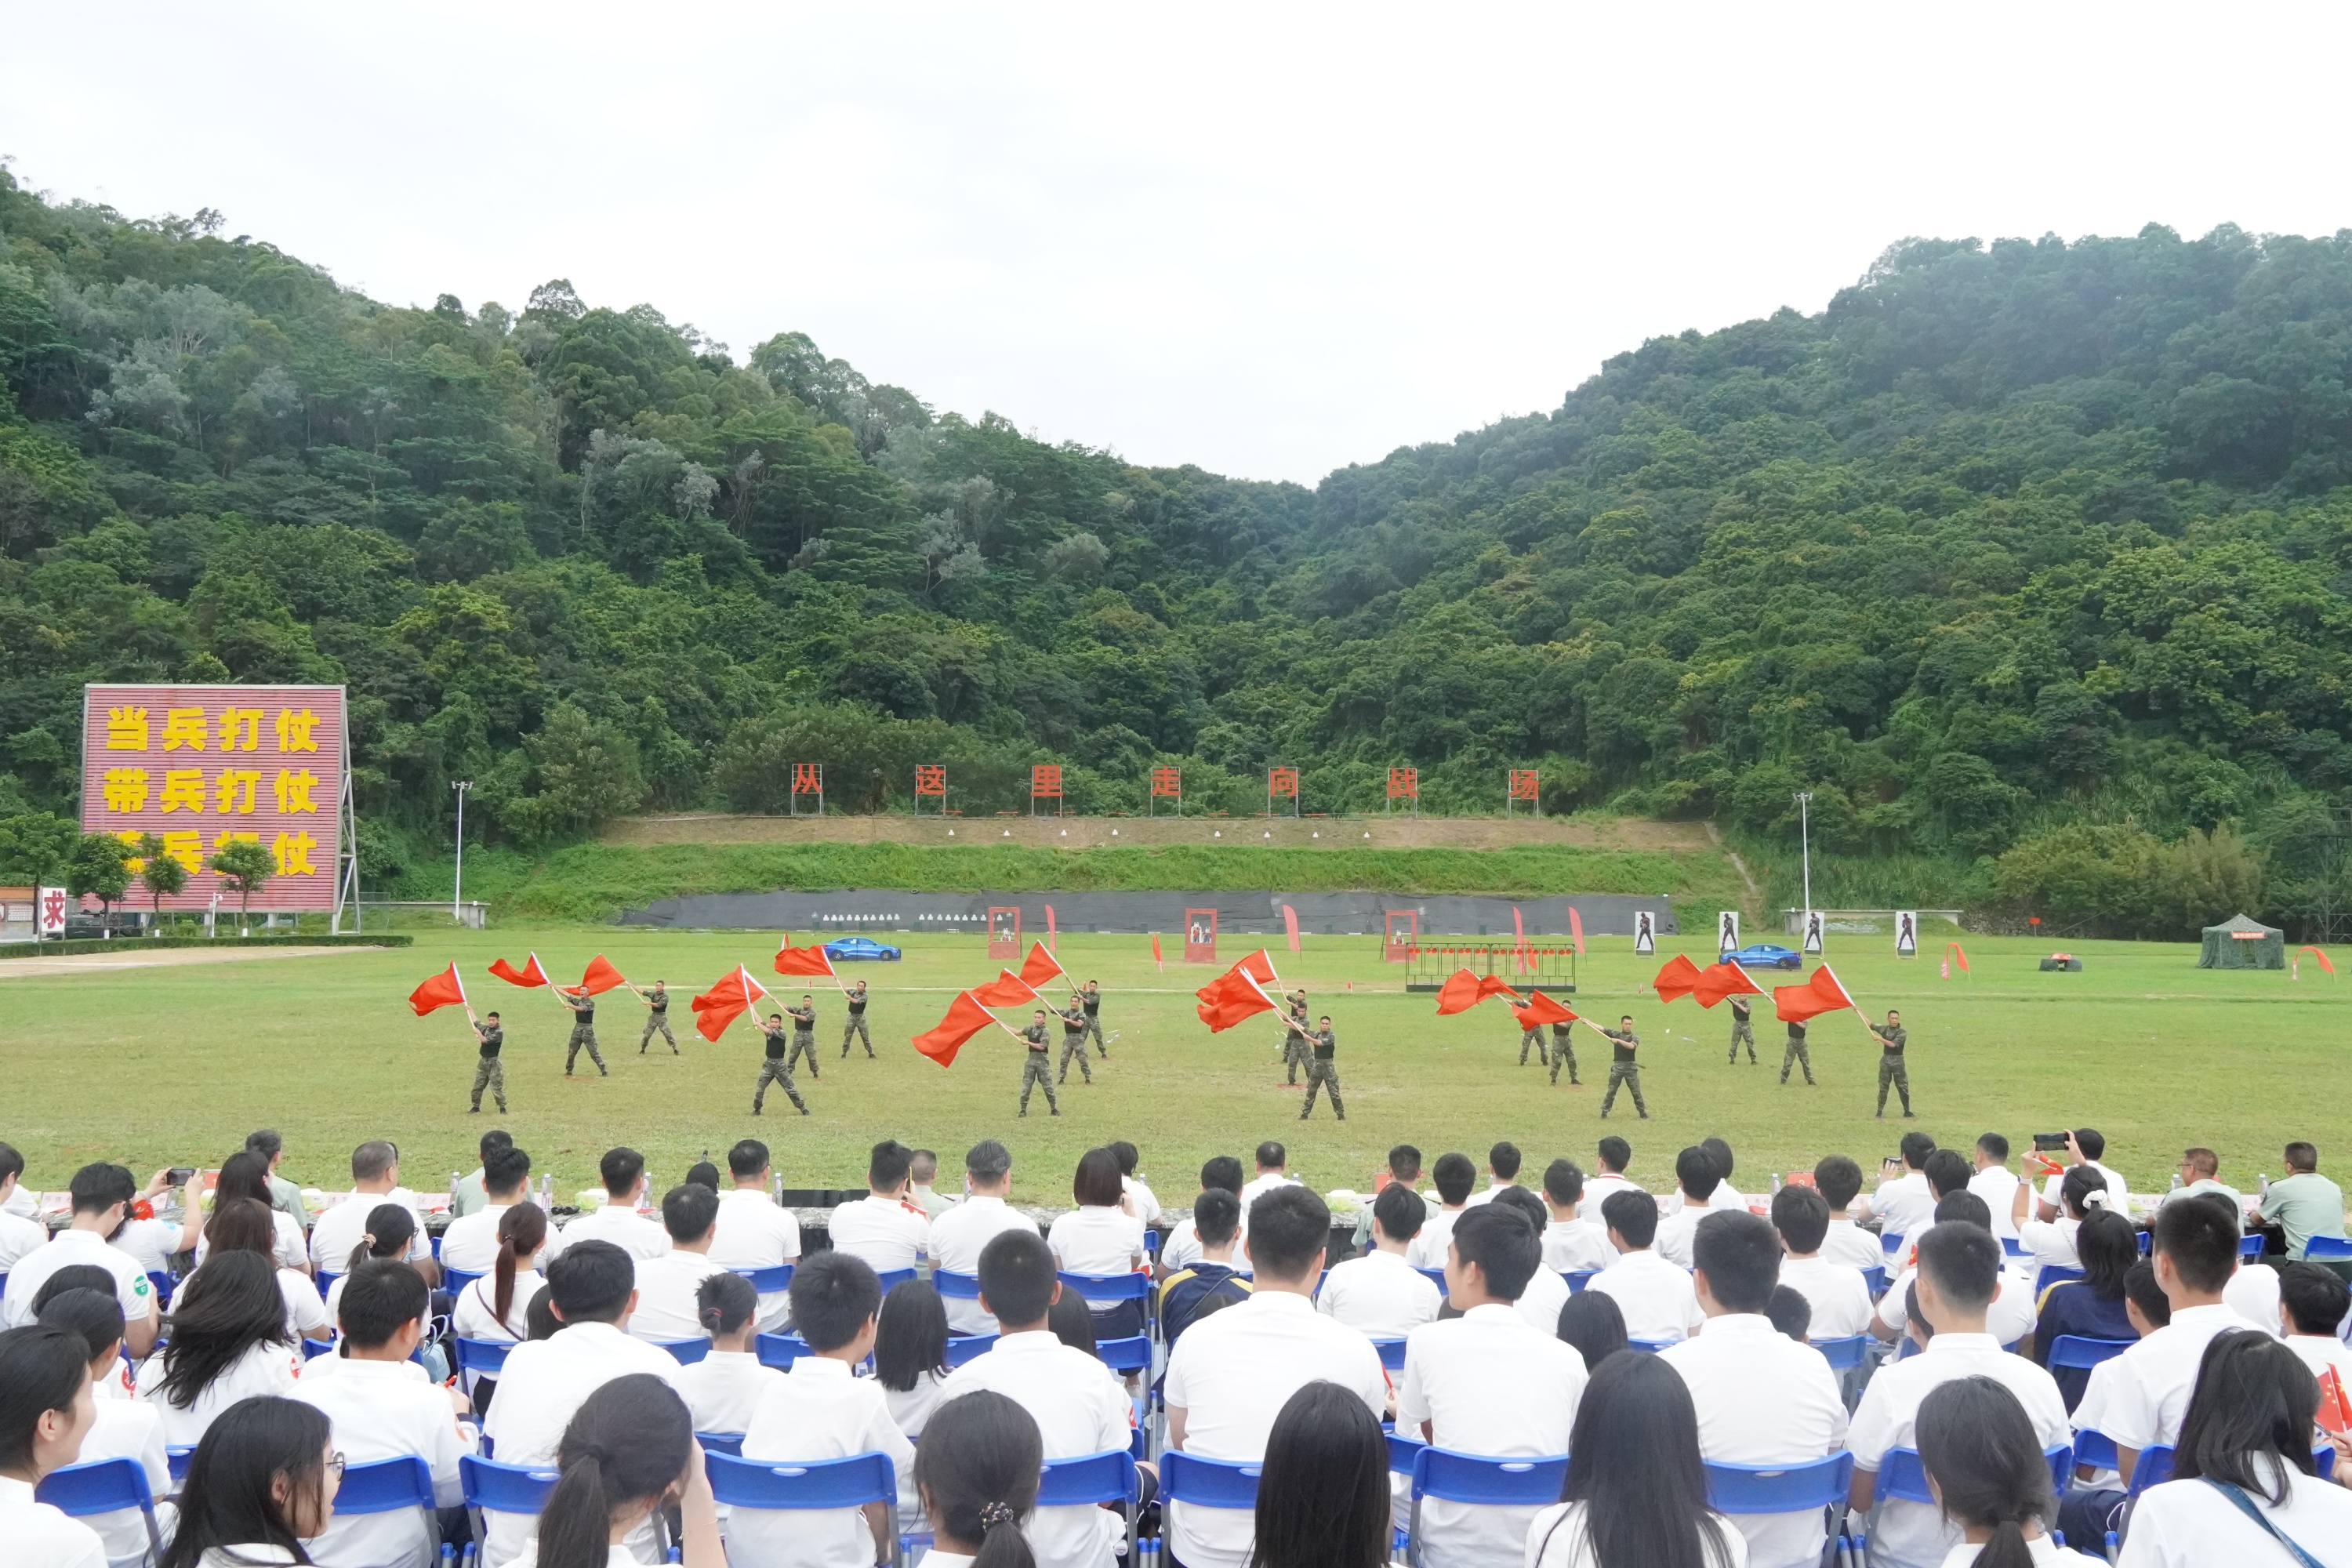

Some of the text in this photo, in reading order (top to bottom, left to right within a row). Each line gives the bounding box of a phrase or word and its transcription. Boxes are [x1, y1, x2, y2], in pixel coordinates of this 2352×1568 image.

[107, 706, 320, 753] 当兵打仗
[103, 768, 319, 815] 带兵打仗
[791, 763, 1540, 799] 从这里走向战场
[43, 890, 64, 929] 求
